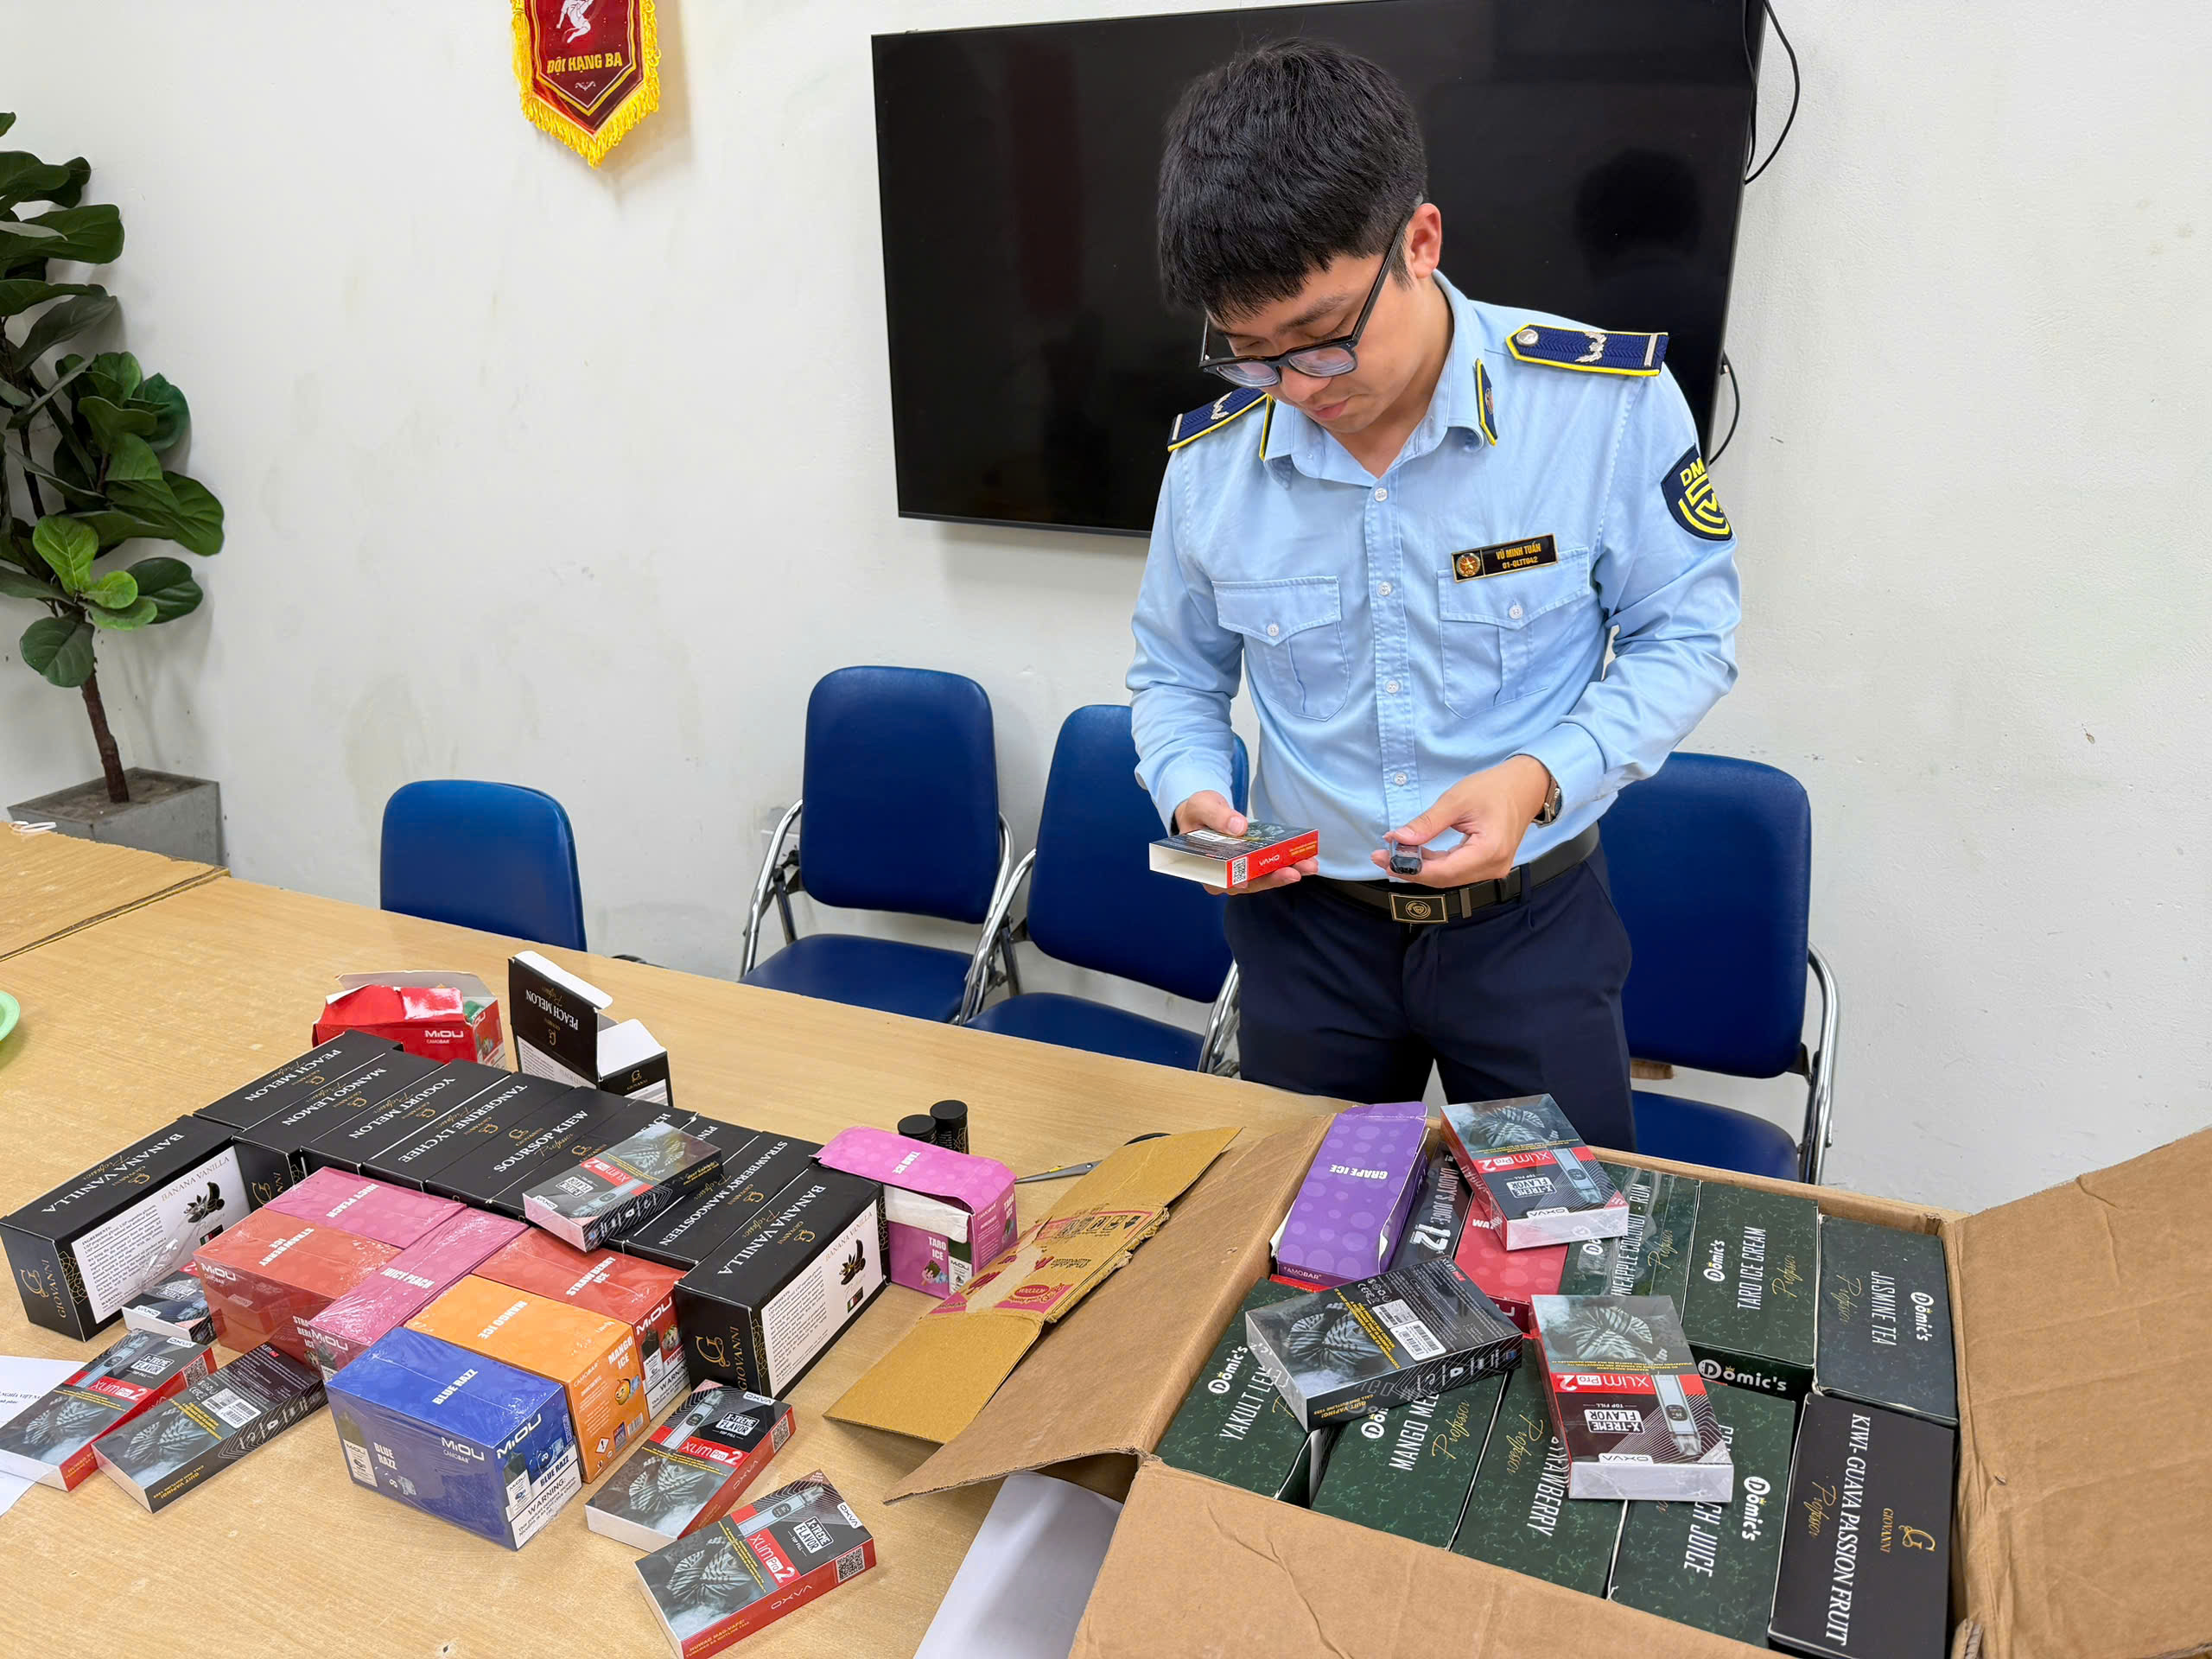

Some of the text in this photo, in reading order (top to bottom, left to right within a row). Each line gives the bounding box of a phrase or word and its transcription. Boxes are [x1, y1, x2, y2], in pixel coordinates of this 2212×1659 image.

[568, 54, 602, 73] HẠNG
[605, 52, 622, 67] BA
[1506, 547, 1523, 558] MINH
[525, 989, 579, 1031] PEACH MELON
[245, 1049, 342, 1102] PEACH MELON
[282, 1068, 387, 1127] MANGO LEMON
[348, 1077, 456, 1139] YOGURT MELON
[398, 1084, 528, 1163] TANGERINE LYCHEE
[493, 1132, 554, 1173] SOURSOP
[726, 1141, 788, 1189] STRAWBERRY
[41, 1133, 185, 1213] BANANA VANILLA
[196, 1156, 230, 1181] VANILLA
[1330, 1164, 1389, 1179] GRAPE ICE
[1478, 1160, 1497, 1172] 2
[1511, 1178, 1548, 1190] FLAVOR
[1511, 1184, 1554, 1198] X-TREME
[658, 1190, 728, 1246] MANGOSTEEN
[717, 1185, 826, 1274] BANANA VANILLA
[269, 1237, 286, 1249] ICE
[928, 1236, 947, 1250] TARO
[931, 1248, 944, 1261] ICE
[380, 1268, 435, 1289] JUICY PEACH
[593, 1272, 610, 1284] ICE
[1737, 1226, 1766, 1310] TARO ICE CREAM
[41, 1259, 67, 1319] GIOVANNI
[478, 1300, 528, 1339] MANGO ICE
[1871, 1271, 1897, 1345] JASMINE TEA
[607, 1336, 633, 1365] MANGO
[618, 1353, 630, 1370] ICE
[729, 1326, 747, 1391] GIOVANNI
[431, 1369, 478, 1405] BLUE RAZZ
[1558, 1374, 1578, 1390] 2
[1580, 1376, 1599, 1385] Pro
[746, 1393, 772, 1405] OXVA
[1350, 1401, 1367, 1412] QUIT
[720, 1420, 750, 1435] FLAVOR
[727, 1412, 757, 1427] X-TREME
[1218, 1392, 1264, 1440] YAKULT
[1590, 1410, 1636, 1421] FLAVOR
[1592, 1421, 1642, 1433] X-TREME
[373, 1442, 395, 1459] BLUE
[728, 1451, 742, 1465] 2
[1389, 1420, 1428, 1471] MANGO
[378, 1453, 397, 1470] RAZZ
[540, 1455, 569, 1487] BLUE RAZZ
[1840, 1456, 1866, 1509] GUAVA
[527, 1478, 566, 1516] WARNING:
[840, 1505, 859, 1527] OXVA
[795, 1524, 820, 1553] FLAVOR
[806, 1519, 831, 1547] X-TREME
[1880, 1508, 1894, 1554] GIOVANNI
[1684, 1523, 1718, 1578] JUICE
[1833, 1510, 1860, 1587] PASSION
[768, 1559, 779, 1571] Pro
[773, 1567, 796, 1584] 2
[771, 1585, 812, 1610] OXVA
[1825, 1585, 1852, 1646] FRUIT
